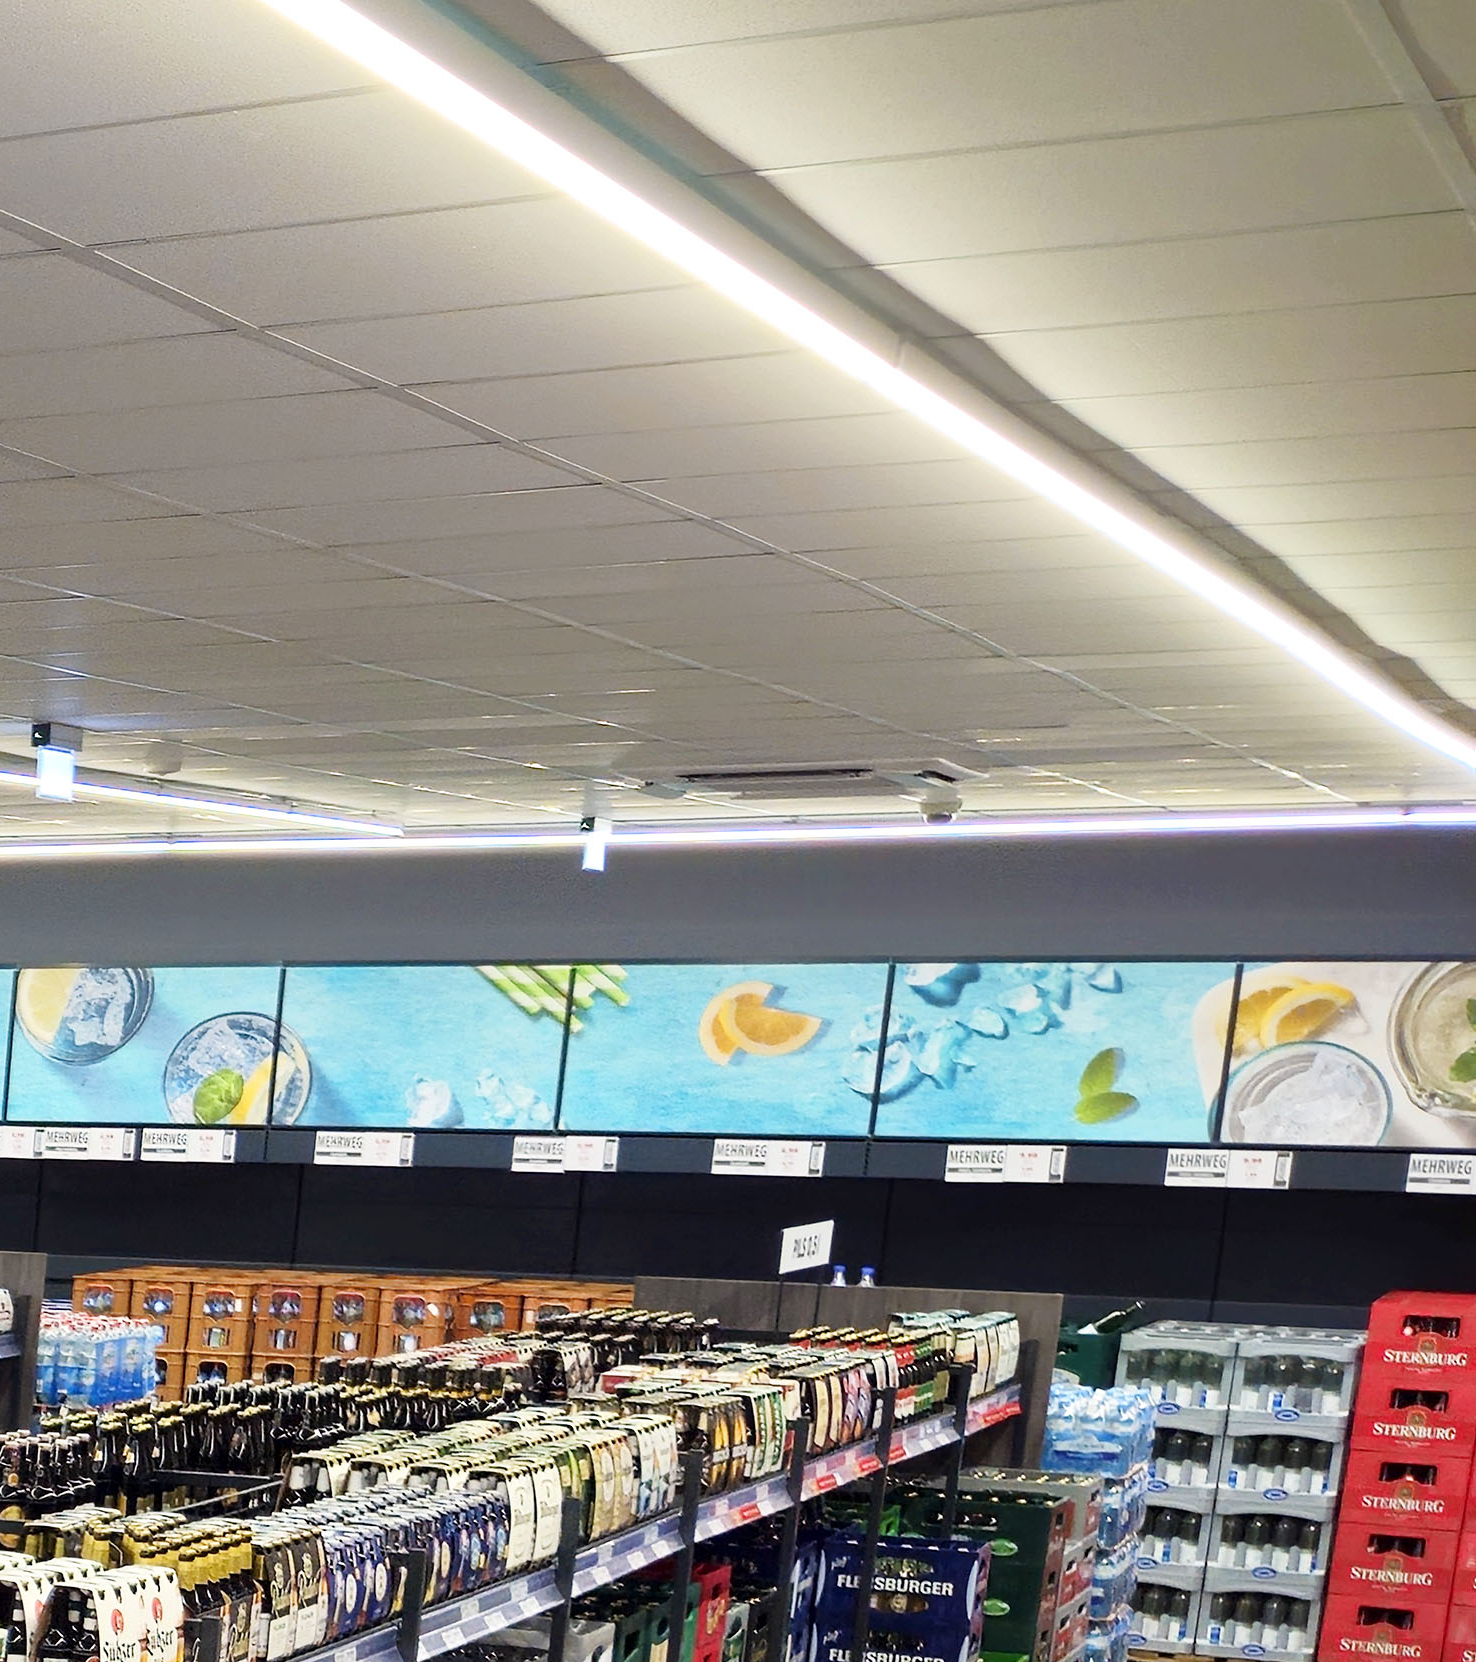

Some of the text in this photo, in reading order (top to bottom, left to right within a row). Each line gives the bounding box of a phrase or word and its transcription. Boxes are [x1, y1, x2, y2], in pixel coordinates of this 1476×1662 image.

[47, 1131, 88, 1143] MEHRWEG
[142, 1132, 187, 1145] MEHRWEG
[318, 1134, 363, 1149] MEHRWEG
[950, 1149, 1004, 1163] MEHRWEG
[1169, 1152, 1226, 1168] MEHRWEG
[1411, 1158, 1472, 1173] MEHRWEG
[1383, 1349, 1468, 1369] STERNBURG
[1373, 1422, 1456, 1443] STERNBURG
[1361, 1495, 1445, 1516] STERNBURG
[1350, 1567, 1433, 1588] STERNBURG
[1339, 1637, 1422, 1659] STERNBURG
